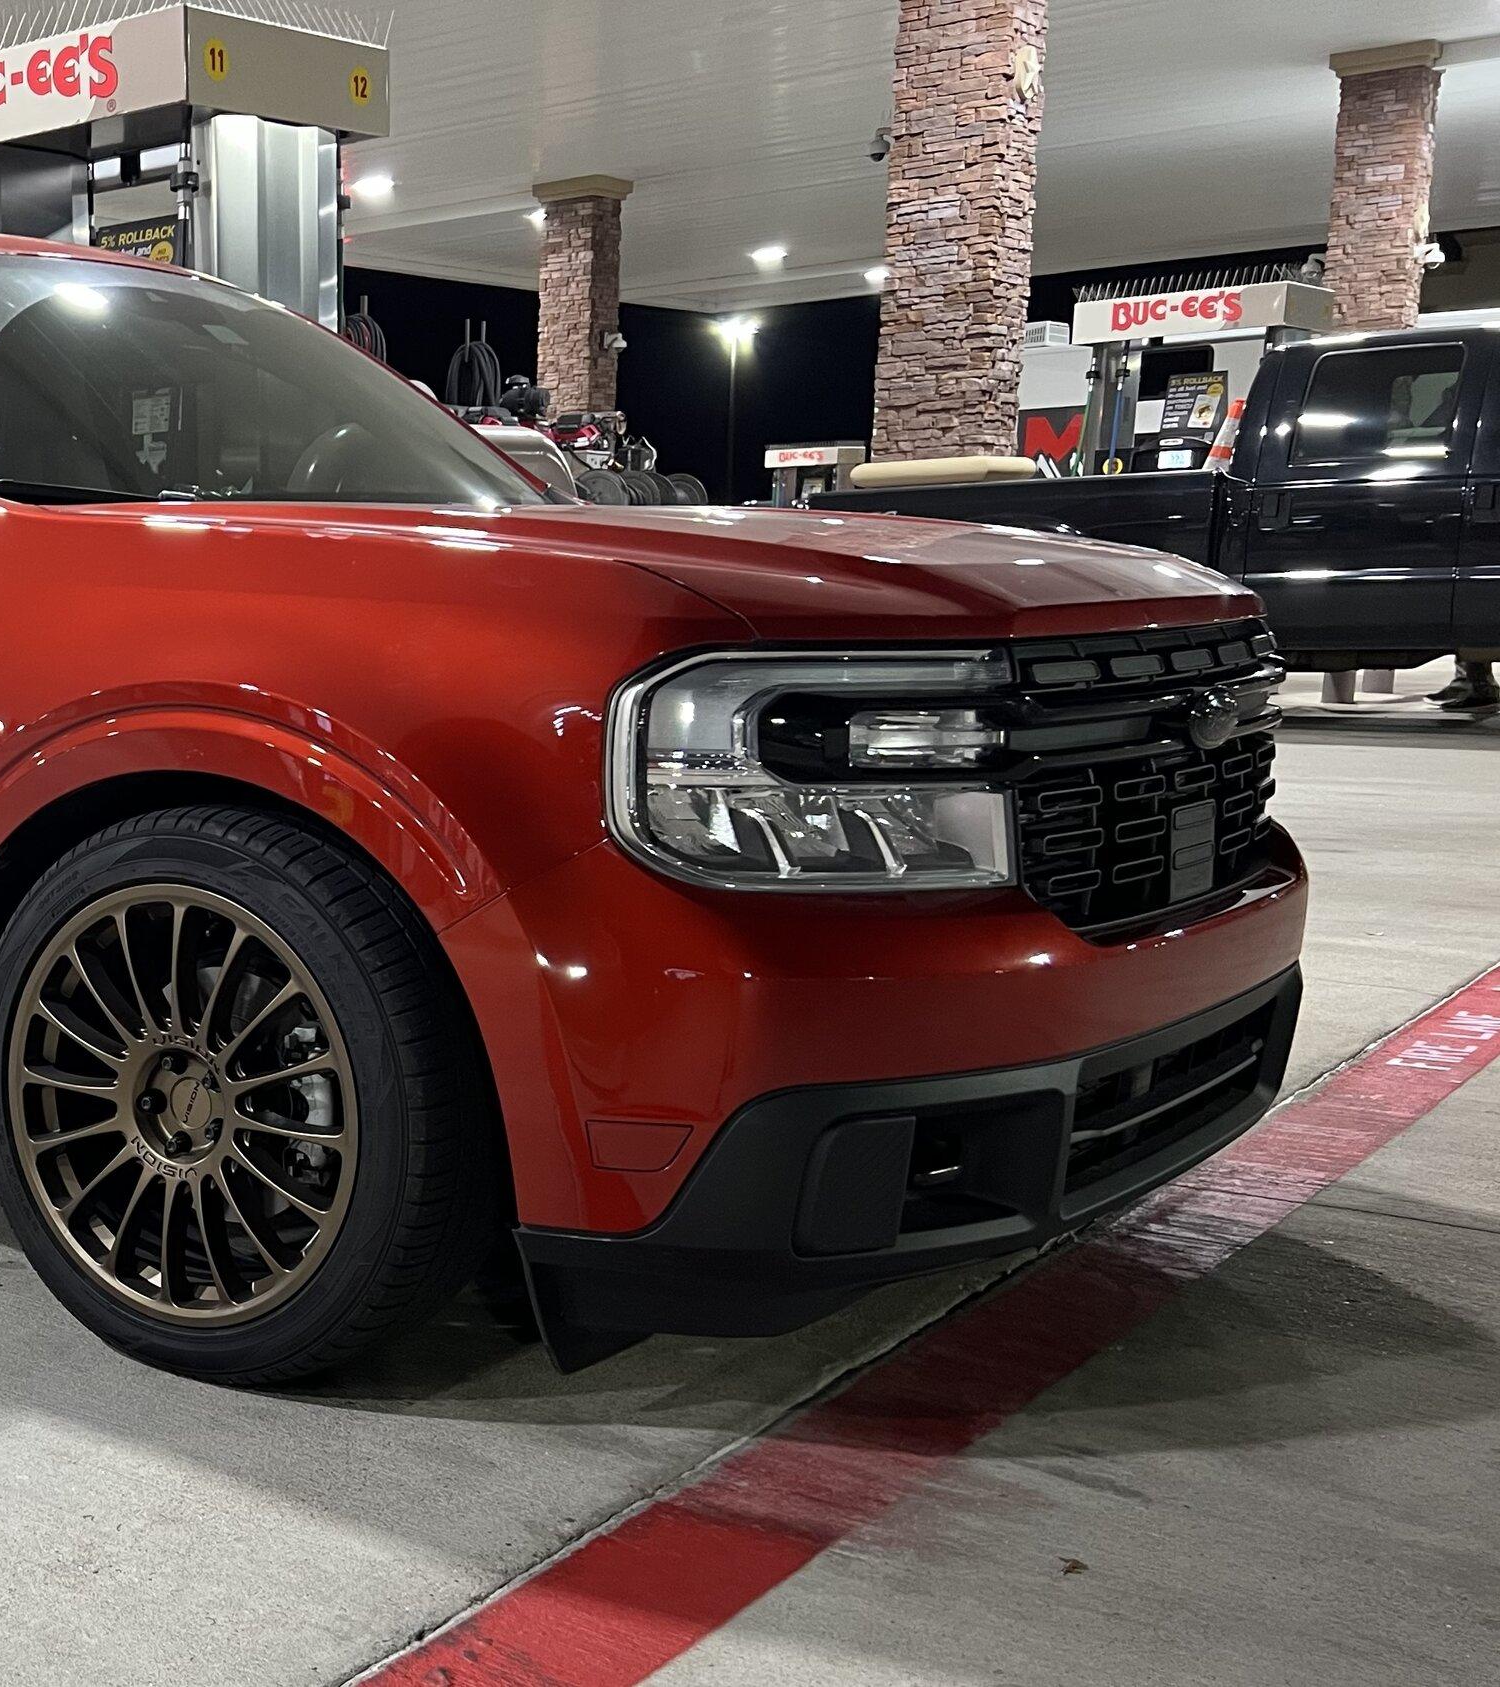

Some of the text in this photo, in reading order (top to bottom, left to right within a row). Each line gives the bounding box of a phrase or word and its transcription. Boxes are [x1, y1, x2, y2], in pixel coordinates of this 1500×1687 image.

[209, 47, 224, 73] 11
[353, 75, 368, 99] 12
[118, 224, 176, 247] ROLLBACK
[1110, 290, 1243, 332] BUC-EE'S
[153, 1034, 221, 1075] VISION
[1385, 1041, 1479, 1070] FIRE
[182, 1081, 201, 1124] VISION
[130, 1135, 198, 1180] VISION
